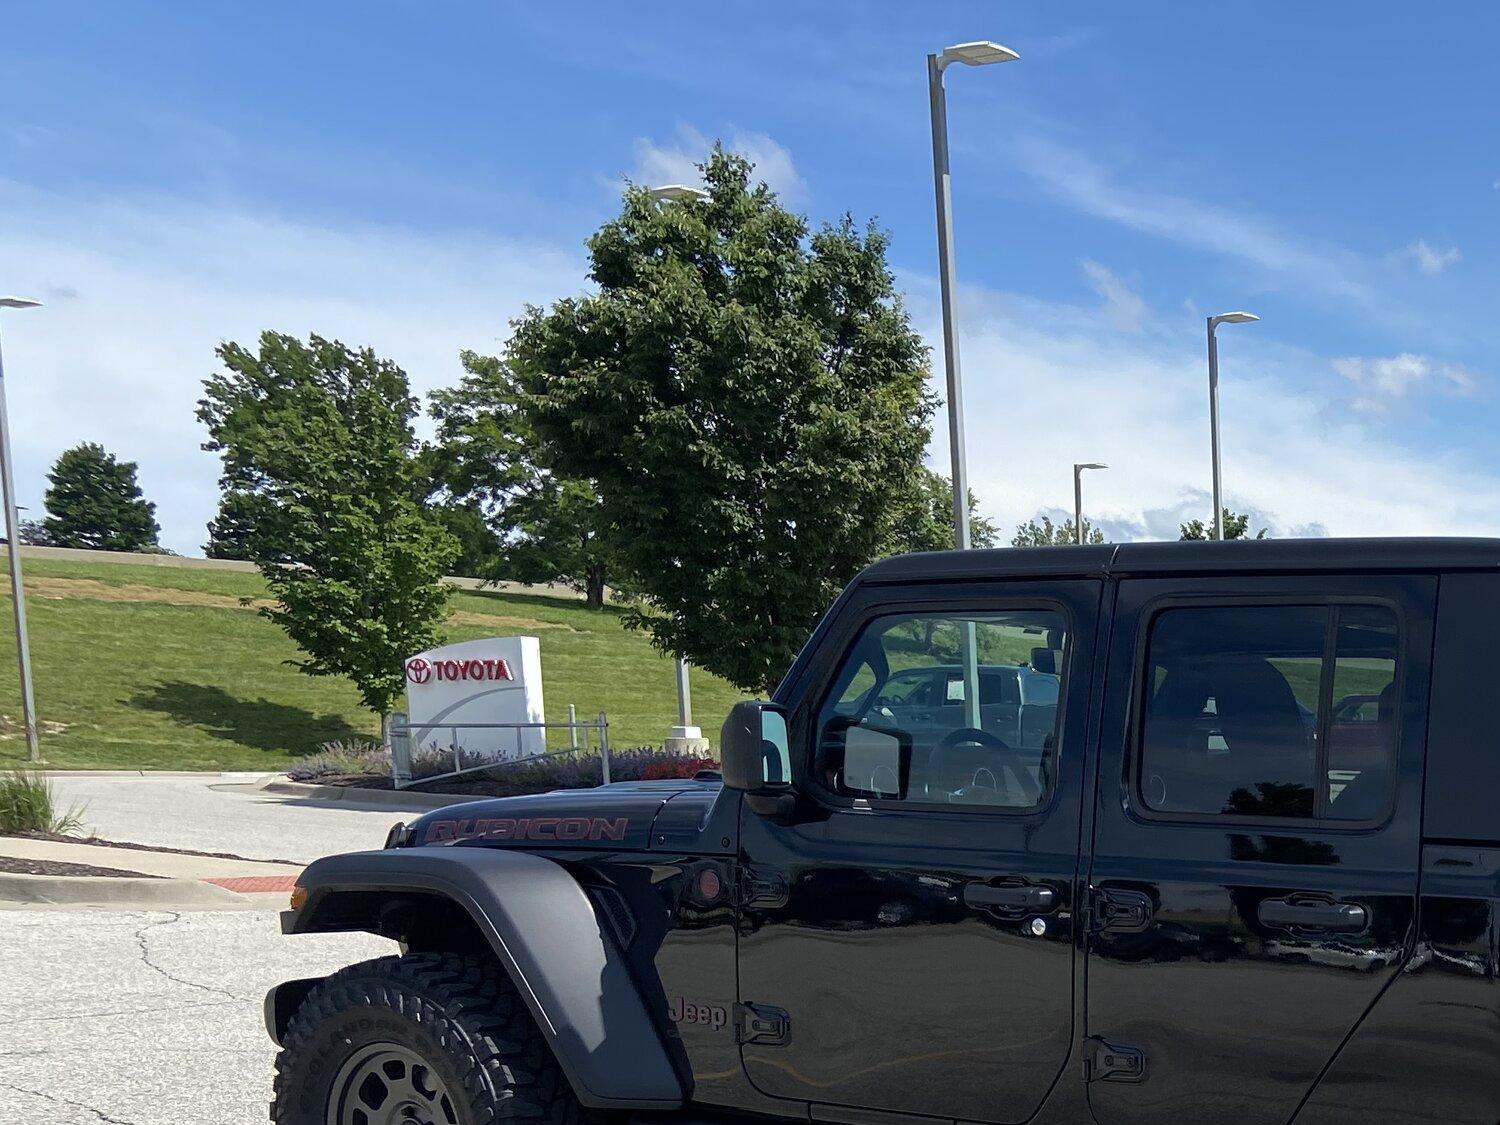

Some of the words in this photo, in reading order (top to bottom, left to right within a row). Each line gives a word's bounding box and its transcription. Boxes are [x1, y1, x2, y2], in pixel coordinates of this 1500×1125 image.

[433, 659, 515, 681] TOYOTA
[424, 817, 629, 841] RUBICON
[668, 996, 727, 1032] Jeep
